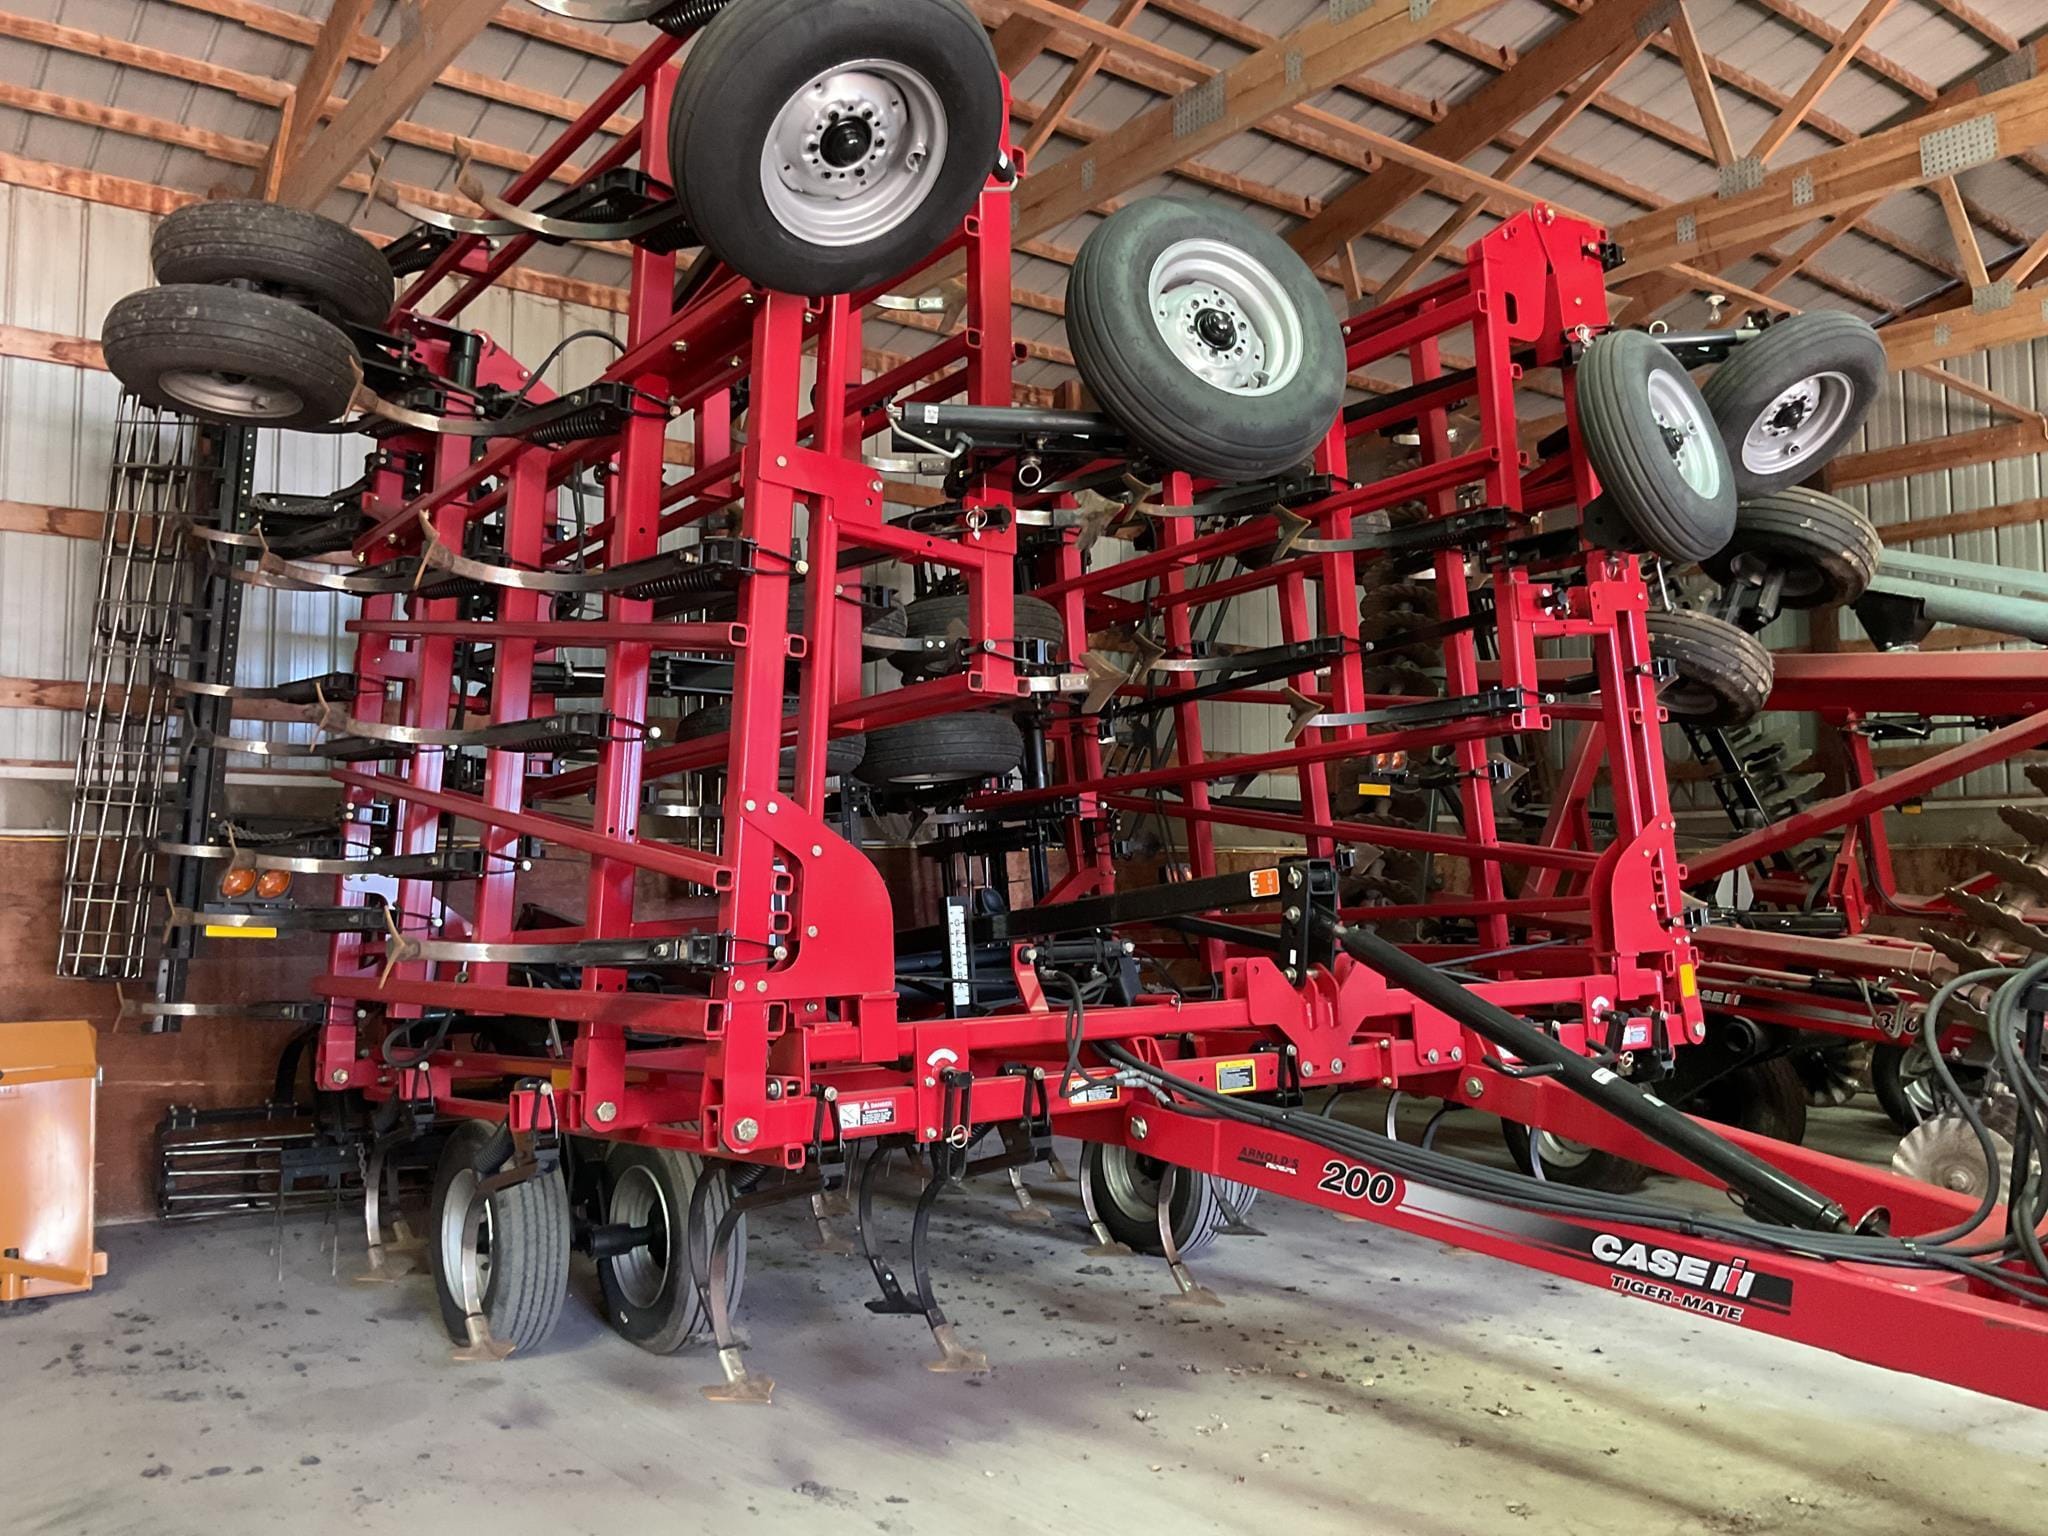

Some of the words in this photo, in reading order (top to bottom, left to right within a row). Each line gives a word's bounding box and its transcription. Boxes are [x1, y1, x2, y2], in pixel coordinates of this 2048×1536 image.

[1318, 1160, 1395, 1206] 200
[1592, 1234, 1710, 1286] CASE
[1611, 1273, 1743, 1322] TIGER-MATE
